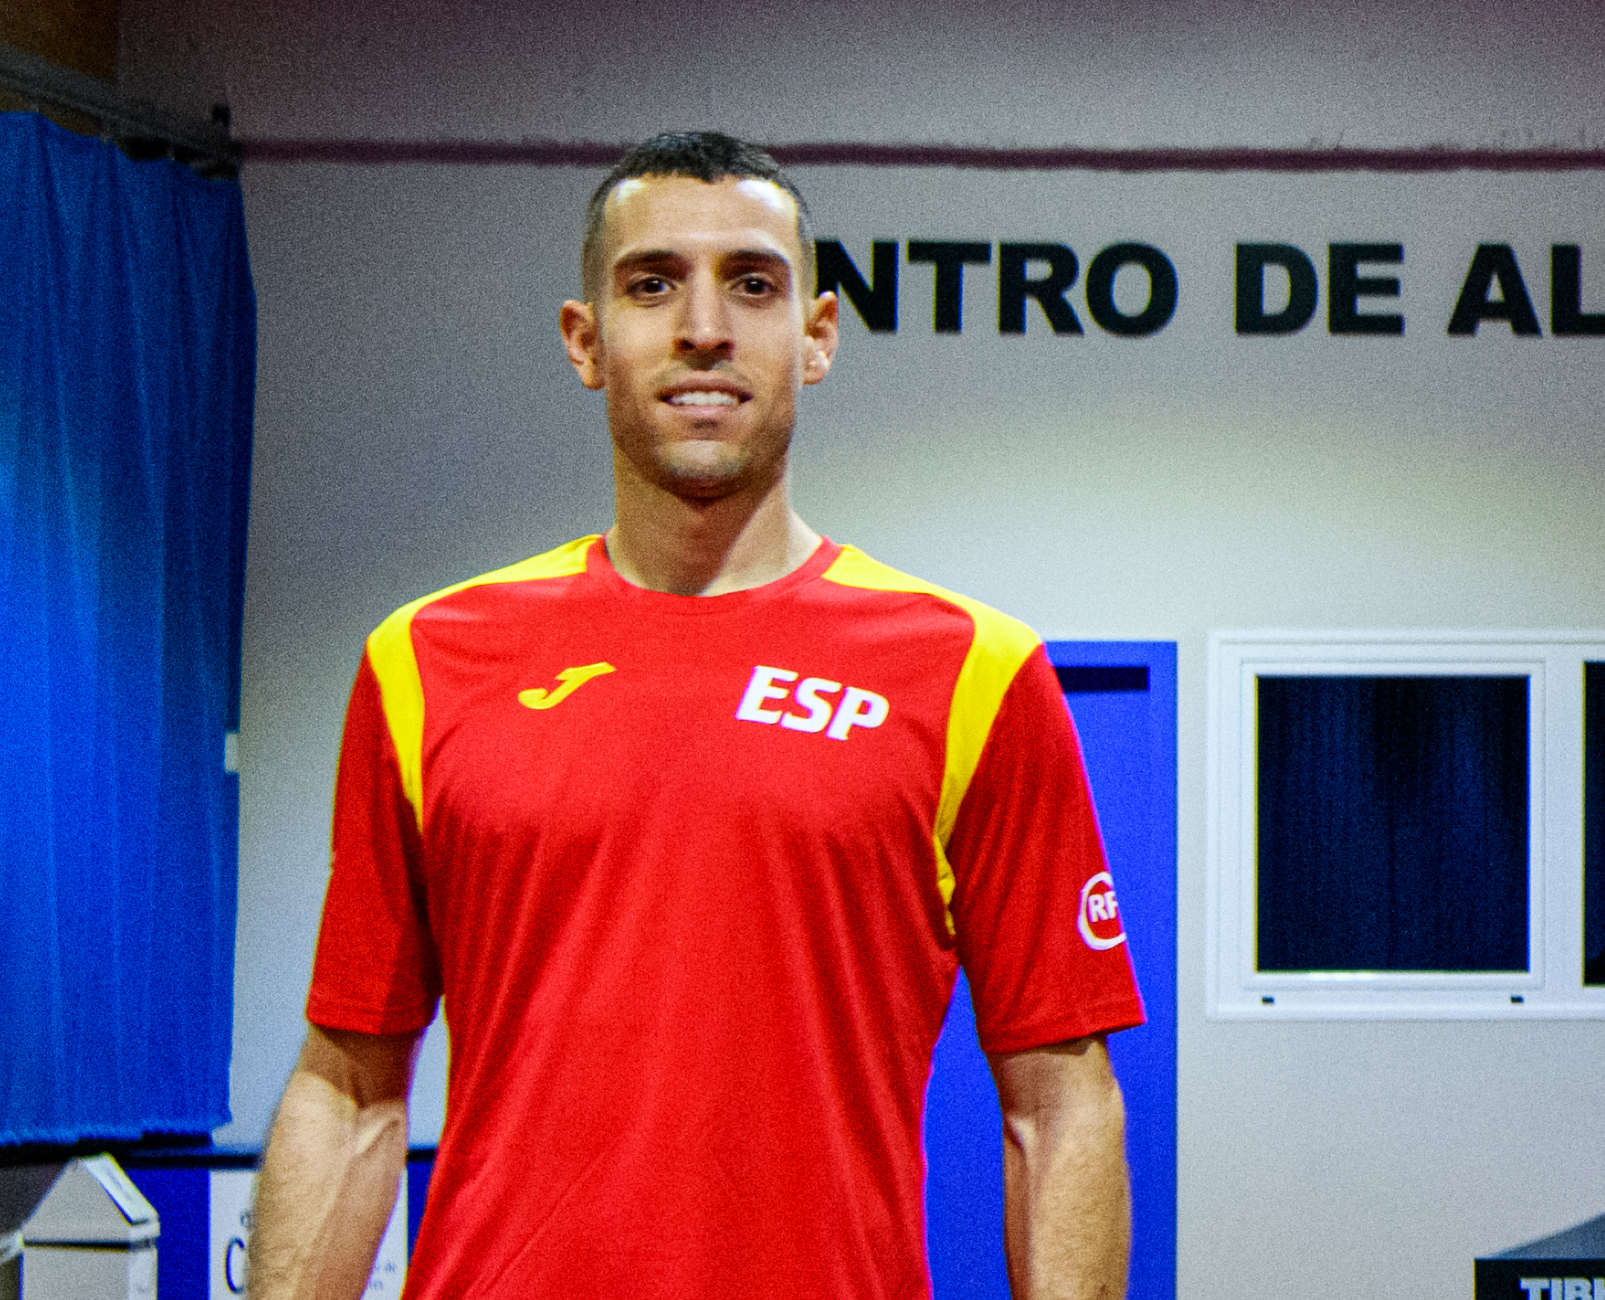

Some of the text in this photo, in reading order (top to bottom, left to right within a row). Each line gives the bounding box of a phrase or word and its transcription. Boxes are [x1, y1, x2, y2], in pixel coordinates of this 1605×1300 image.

[814, 239, 1179, 337] NTRO
[1234, 242, 1405, 336] DE
[735, 664, 890, 741] ESP
